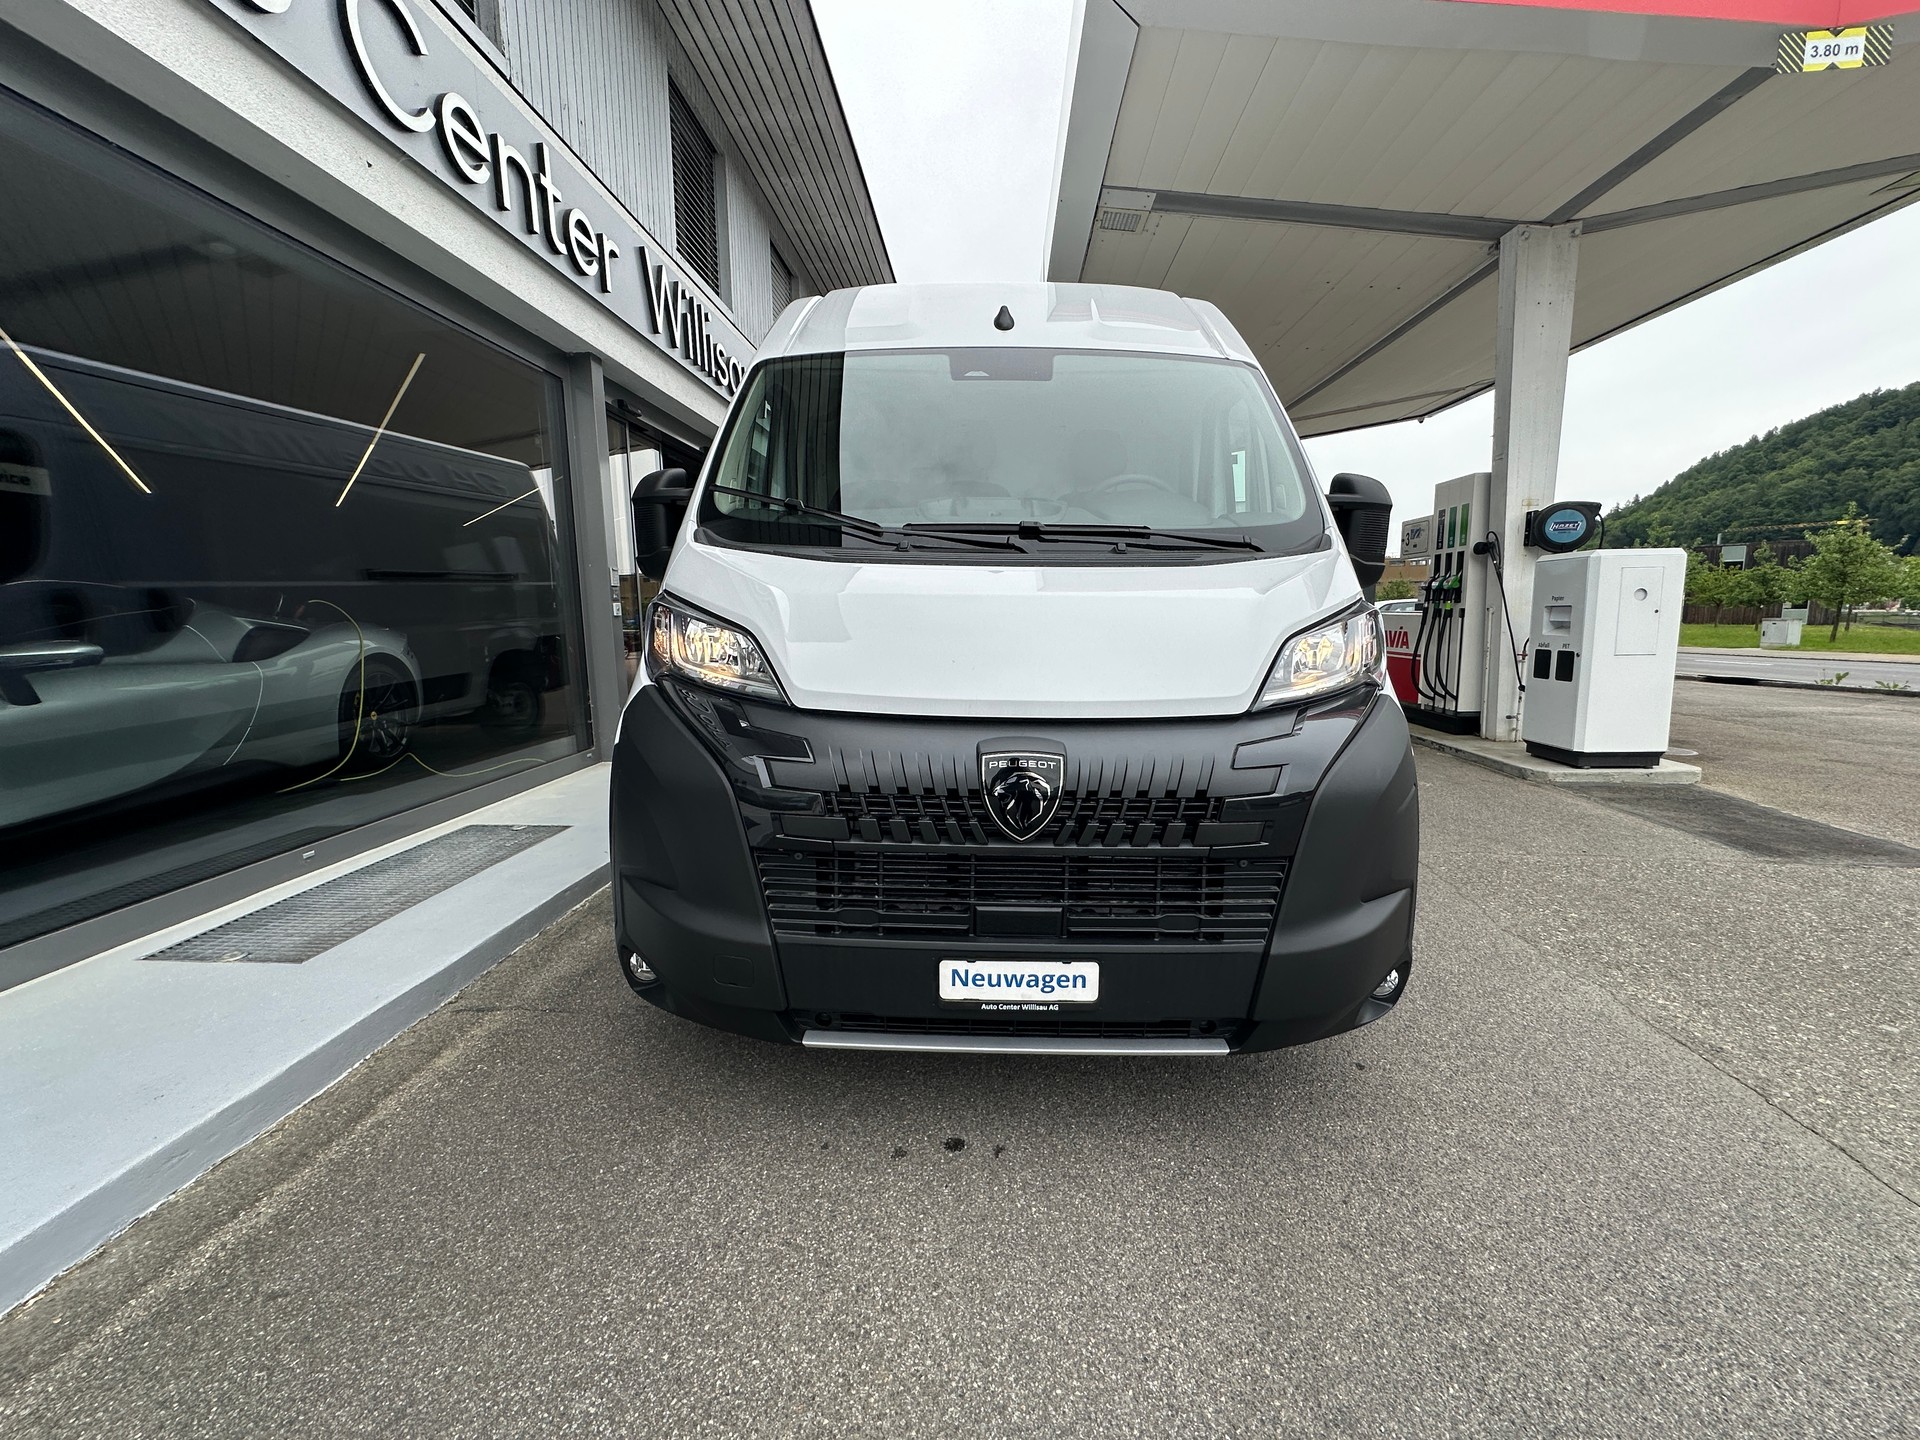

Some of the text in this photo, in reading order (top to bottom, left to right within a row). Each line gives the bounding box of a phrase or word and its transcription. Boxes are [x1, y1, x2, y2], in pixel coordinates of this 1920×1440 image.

[1810, 43, 1859, 58] 3.80 m
[337, 0, 746, 397] Center Willisa
[1551, 522, 1580, 530] HAZET
[1405, 532, 1410, 547] 3
[988, 760, 1057, 769] PEUGEOT
[951, 968, 1087, 994] Neuwagen
[1021, 1003, 1048, 1011] Willisau
